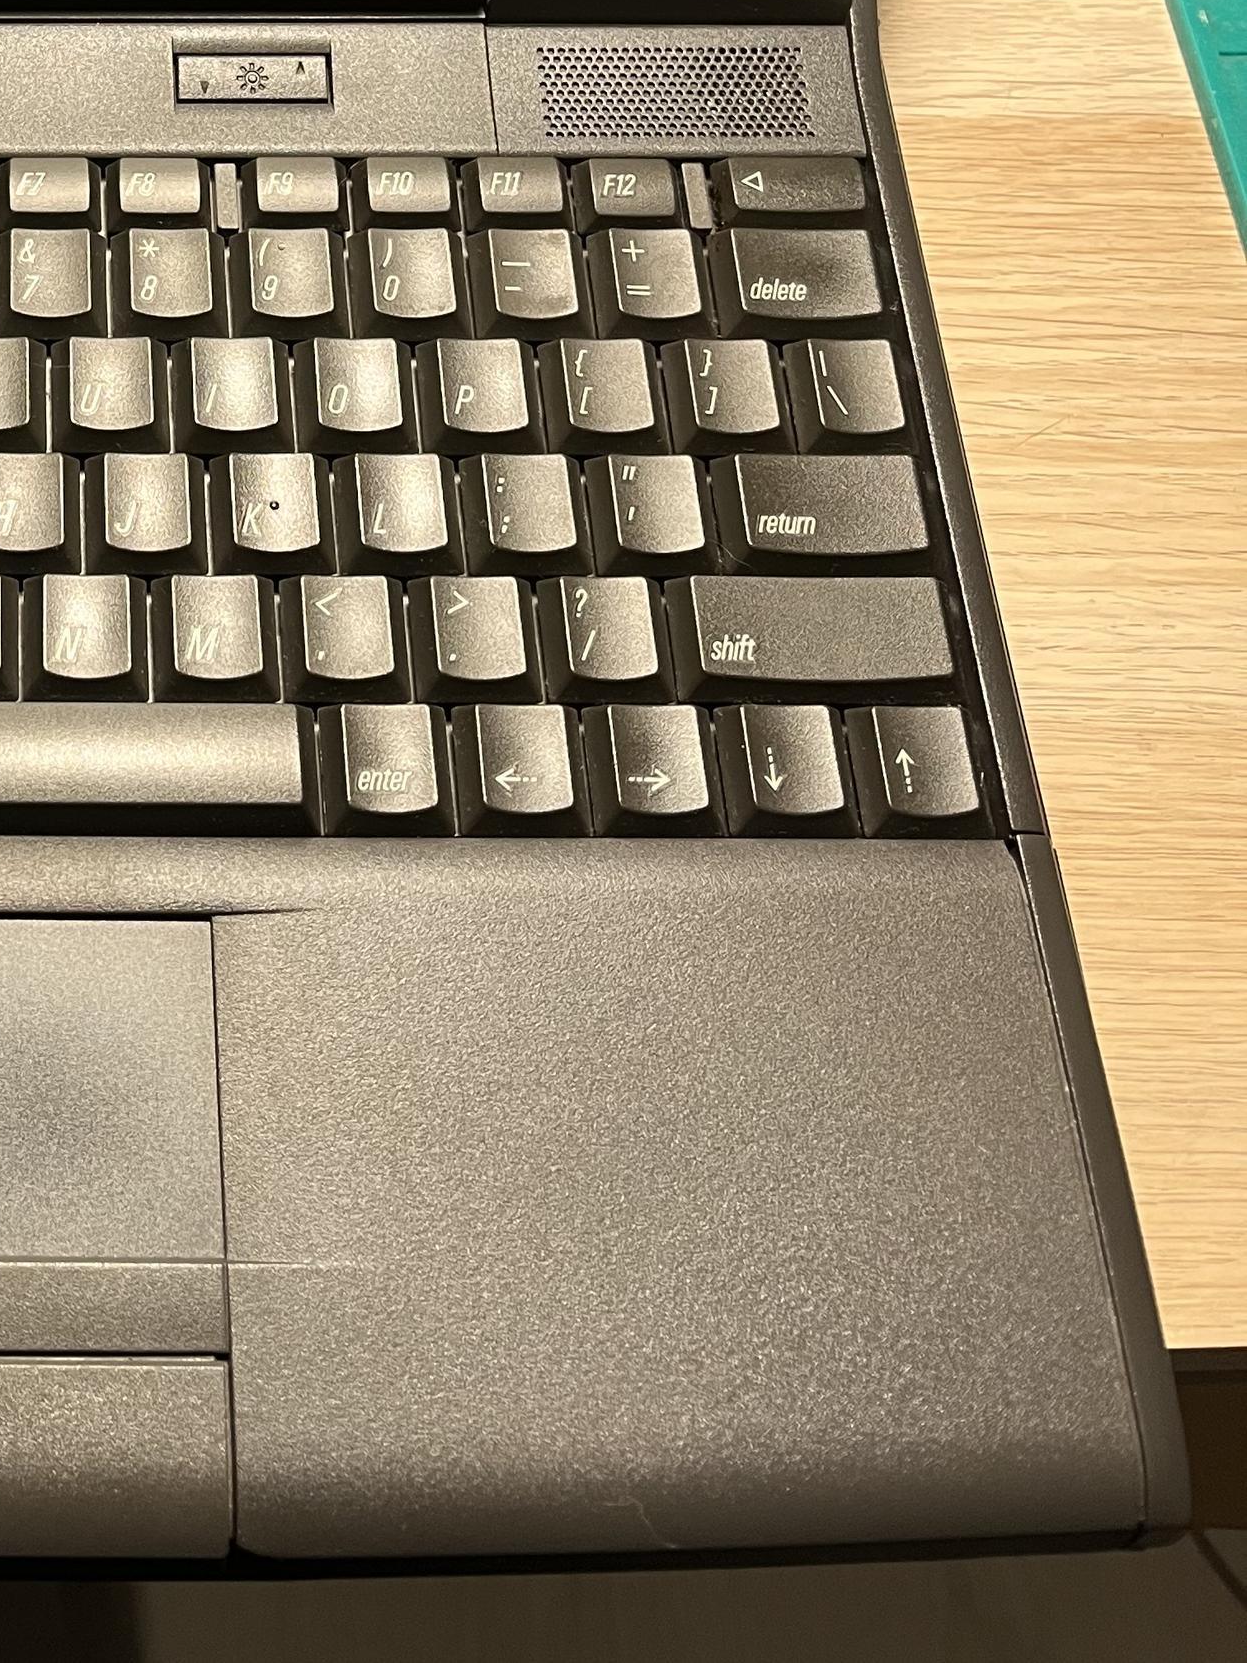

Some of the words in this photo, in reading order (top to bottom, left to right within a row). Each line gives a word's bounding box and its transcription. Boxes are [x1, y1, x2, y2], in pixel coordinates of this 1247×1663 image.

[17, 172, 46, 196] F7
[126, 172, 156, 196] F8
[267, 172, 294, 196] F9
[380, 172, 413, 195] F10
[489, 172, 521, 196] F11
[603, 174, 637, 196] F12
[22, 275, 42, 302] 7
[140, 275, 158, 302] 8
[261, 275, 280, 301] 9
[383, 275, 401, 302] 0
[750, 280, 808, 302] delete
[80, 384, 103, 416] U
[327, 384, 349, 415] O
[454, 386, 475, 415] P
[114, 502, 136, 535] J
[240, 503, 263, 535] K
[372, 503, 389, 535] L
[757, 513, 816, 535] return
[53, 626, 85, 662] N
[185, 626, 220, 660] M
[710, 634, 756, 661] shift
[357, 767, 413, 792] enter
